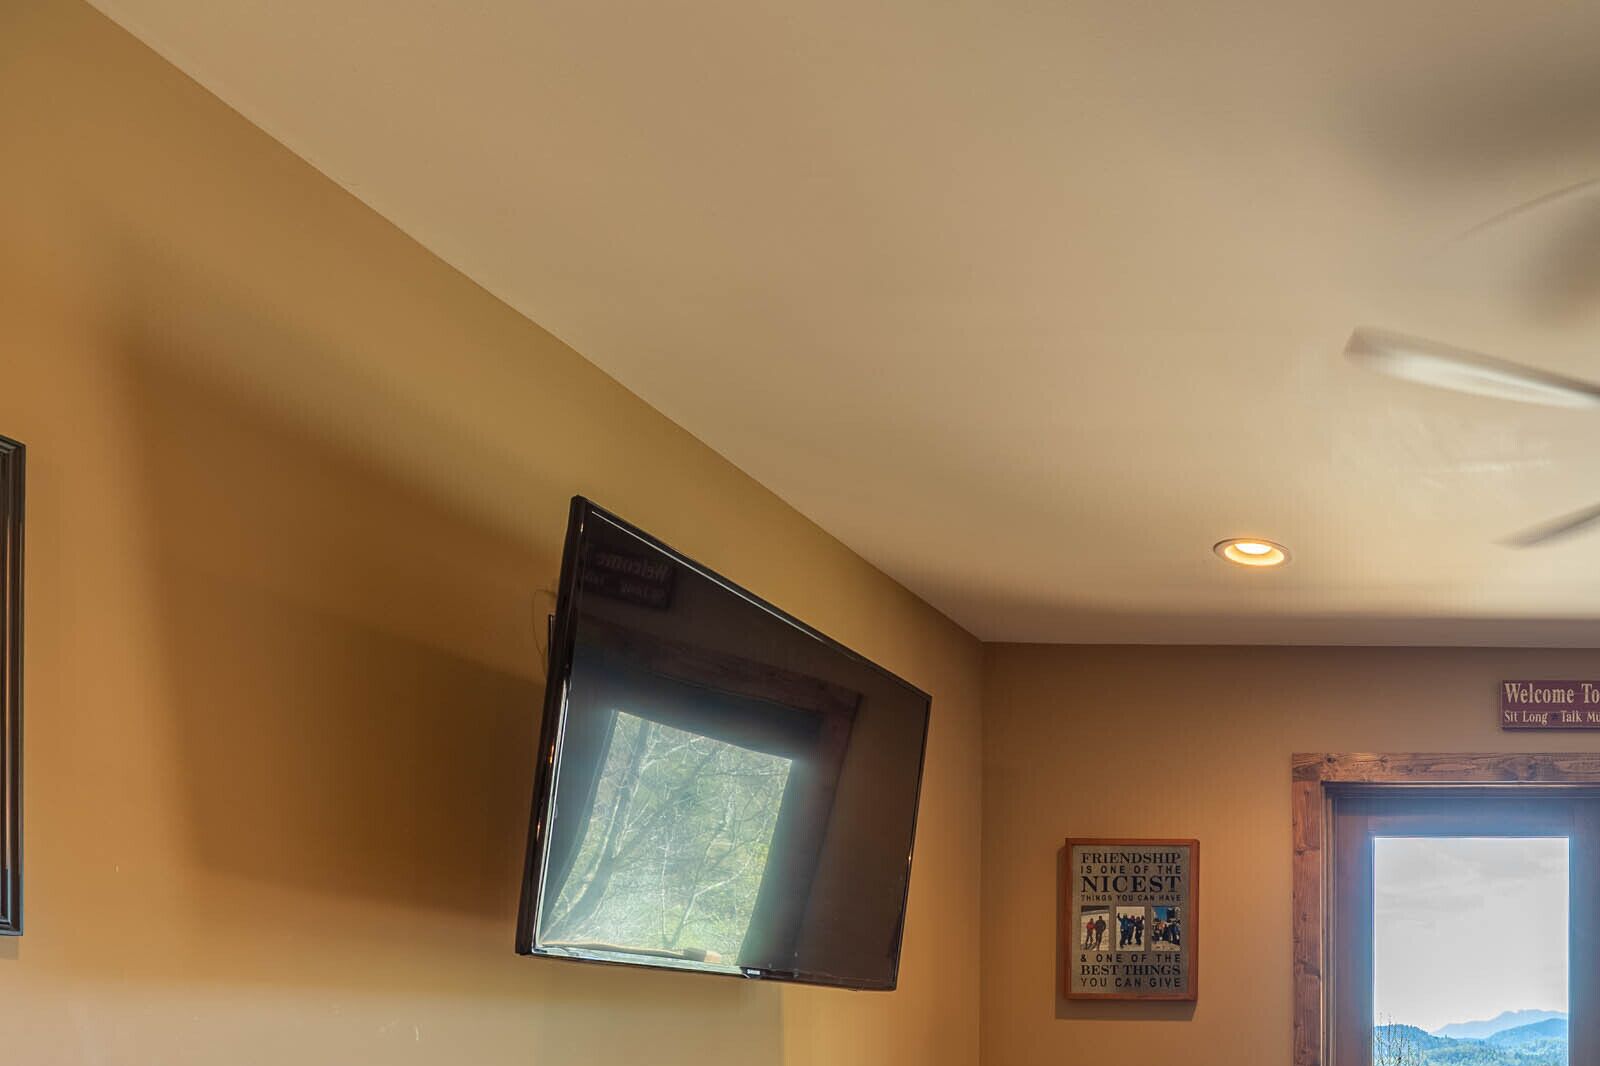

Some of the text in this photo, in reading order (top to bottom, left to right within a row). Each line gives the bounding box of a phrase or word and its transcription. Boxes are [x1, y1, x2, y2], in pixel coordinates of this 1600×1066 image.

[1504, 682, 1575, 704] Welcome
[1581, 683, 1600, 704] To
[1504, 711, 1518, 723] Sit
[1522, 711, 1548, 726] Long
[1561, 711, 1583, 723] Talk
[1081, 852, 1182, 864] FRIENDSHIP
[1081, 865, 1182, 874] IS ONE OF THE
[1081, 875, 1182, 893] NICEST
[1081, 894, 1182, 902] THINGS YOU CAN HAVE
[1081, 954, 1181, 963] & ONE OF THE
[1080, 964, 1181, 976] BEST THINGS
[1081, 977, 1182, 988] YOU CAN GIVE
